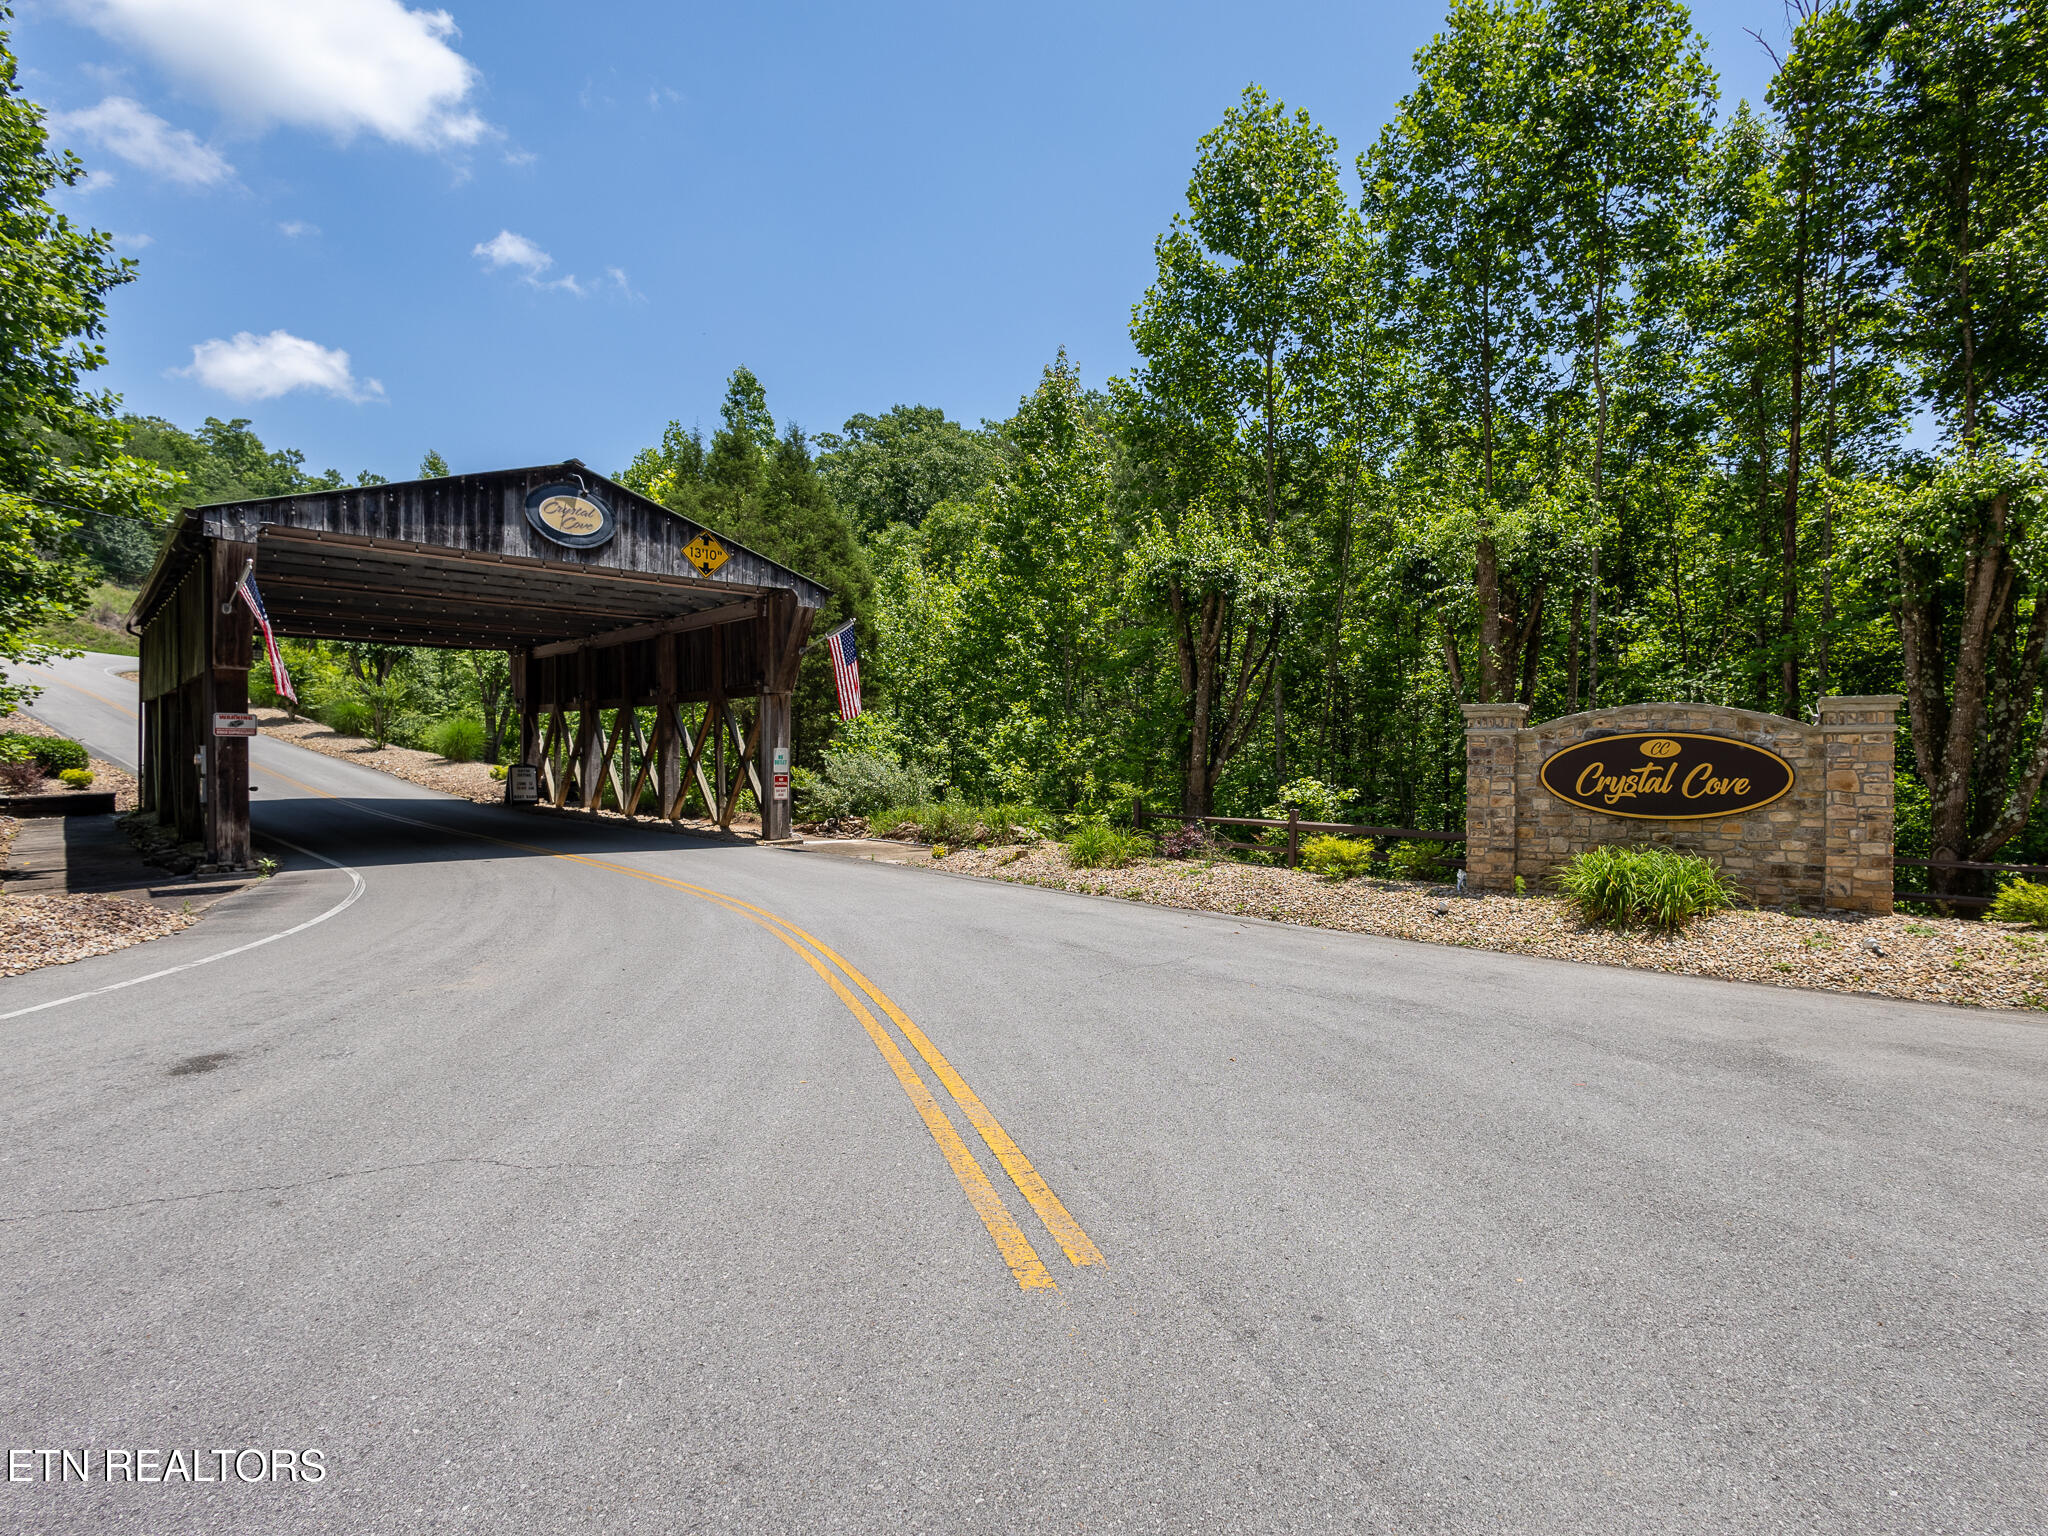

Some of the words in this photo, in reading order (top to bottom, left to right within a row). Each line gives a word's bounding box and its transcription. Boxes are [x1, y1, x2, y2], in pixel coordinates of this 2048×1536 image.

[543, 501, 596, 519] Crystal
[560, 517, 593, 530] Cove
[1650, 741, 1671, 756] CC
[1575, 762, 1679, 805] Crystal
[1681, 763, 1751, 799] Cove
